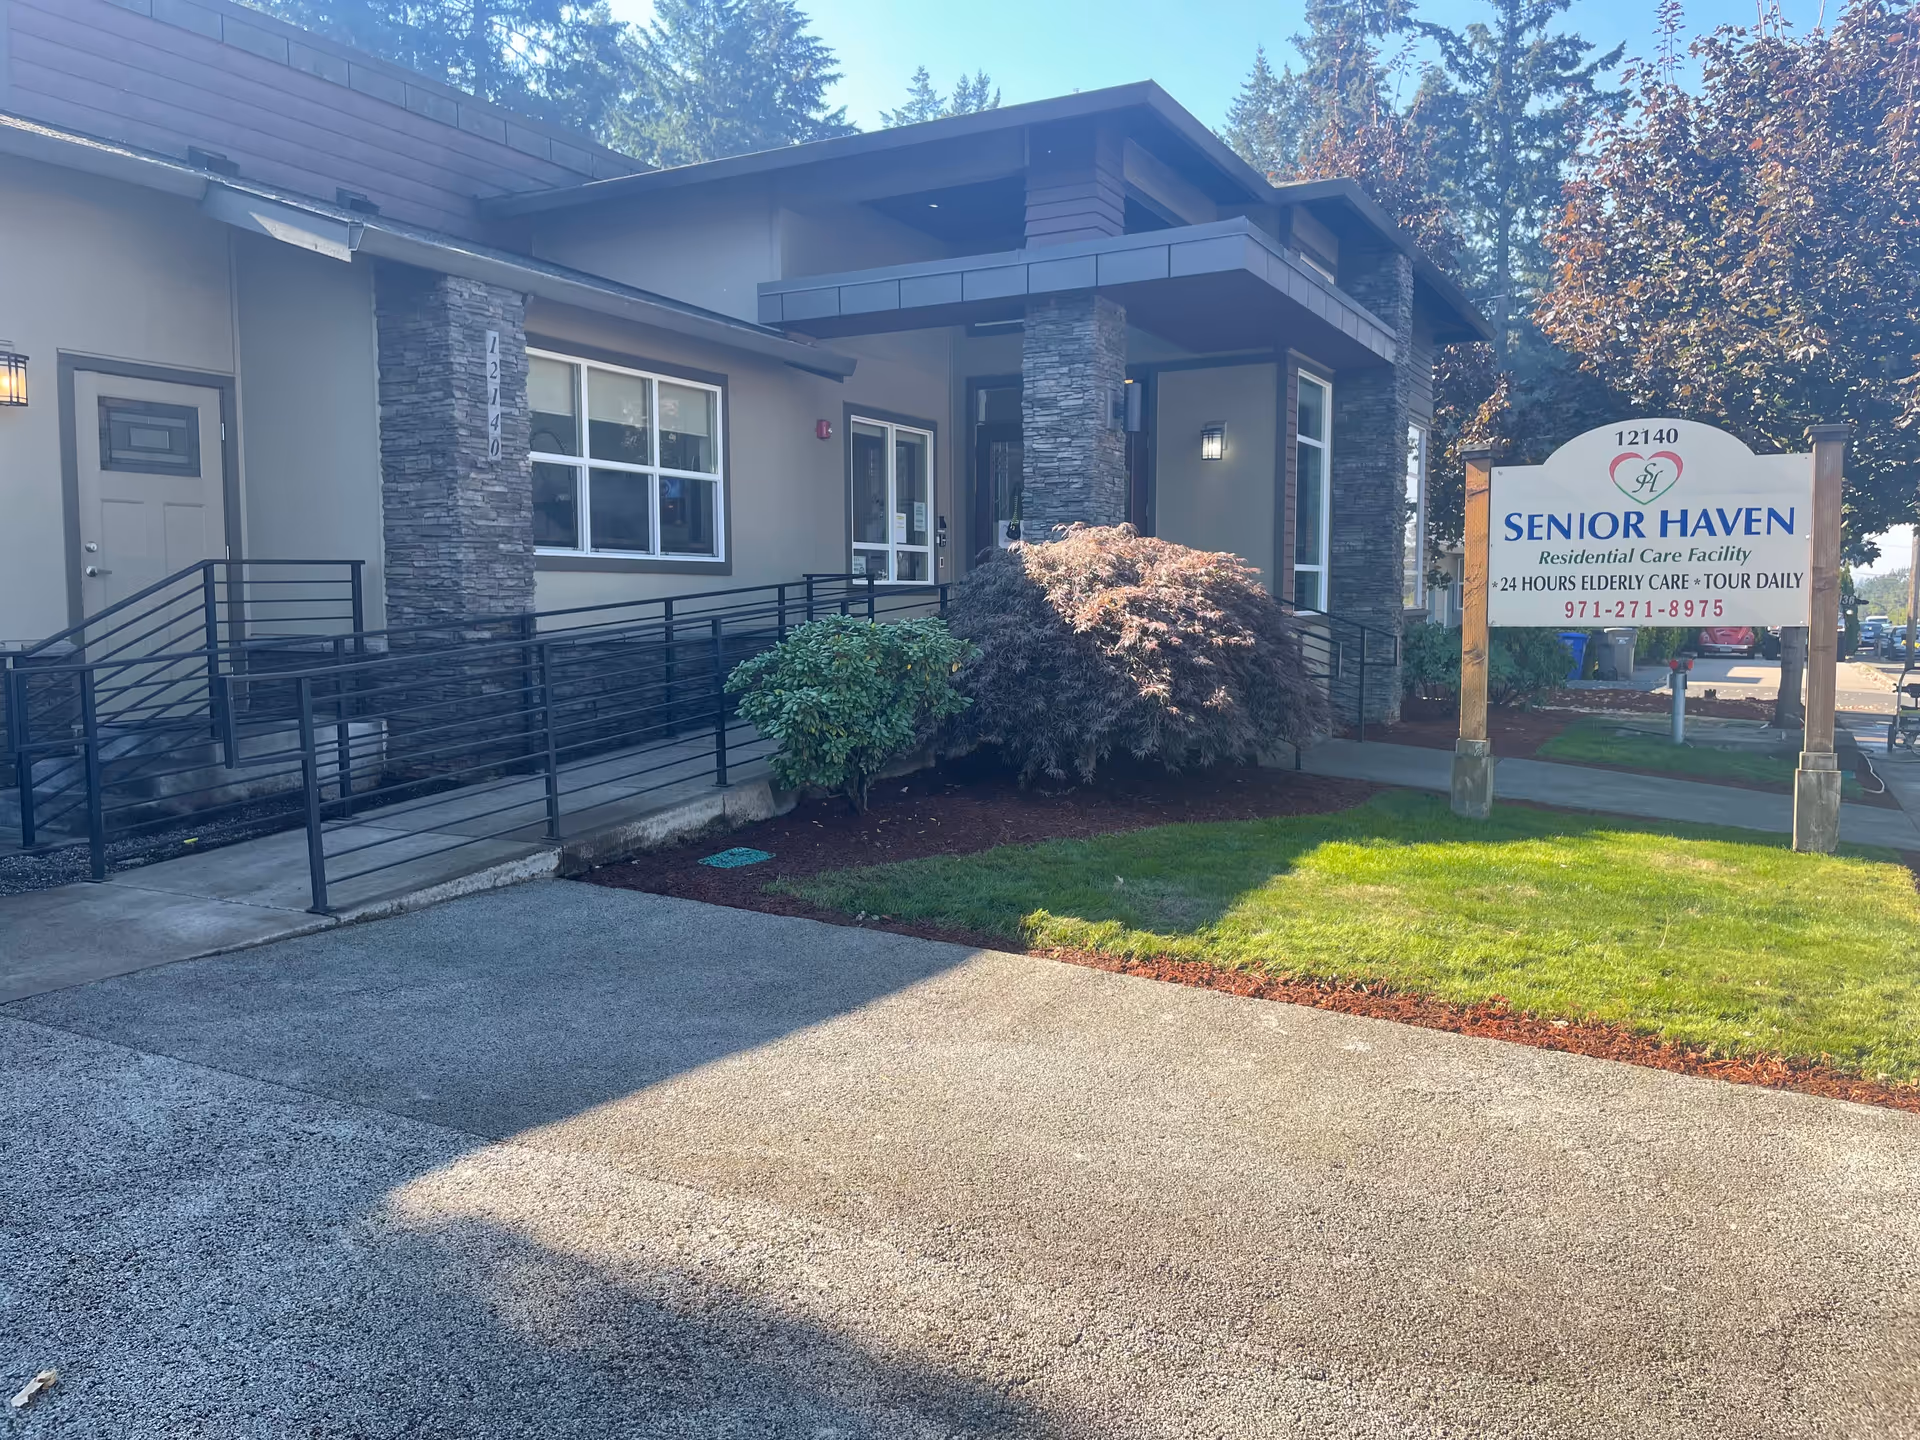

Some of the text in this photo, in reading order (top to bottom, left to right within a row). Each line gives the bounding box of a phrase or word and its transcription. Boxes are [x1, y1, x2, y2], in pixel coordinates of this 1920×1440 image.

[489, 336, 500, 457] 12140
[1615, 428, 1679, 446] 12140
[1504, 507, 1795, 541] SENIOR HAVEN
[1538, 545, 1752, 566] Residential Care Facility
[1522, 575, 1576, 591] HOURS
[1581, 574, 1645, 591] ELDERLY
[1648, 573, 1689, 590] CARE
[1704, 572, 1751, 589] TOUR
[1756, 572, 1804, 589] DAILY
[1564, 599, 1723, 619] 971-271-8975
